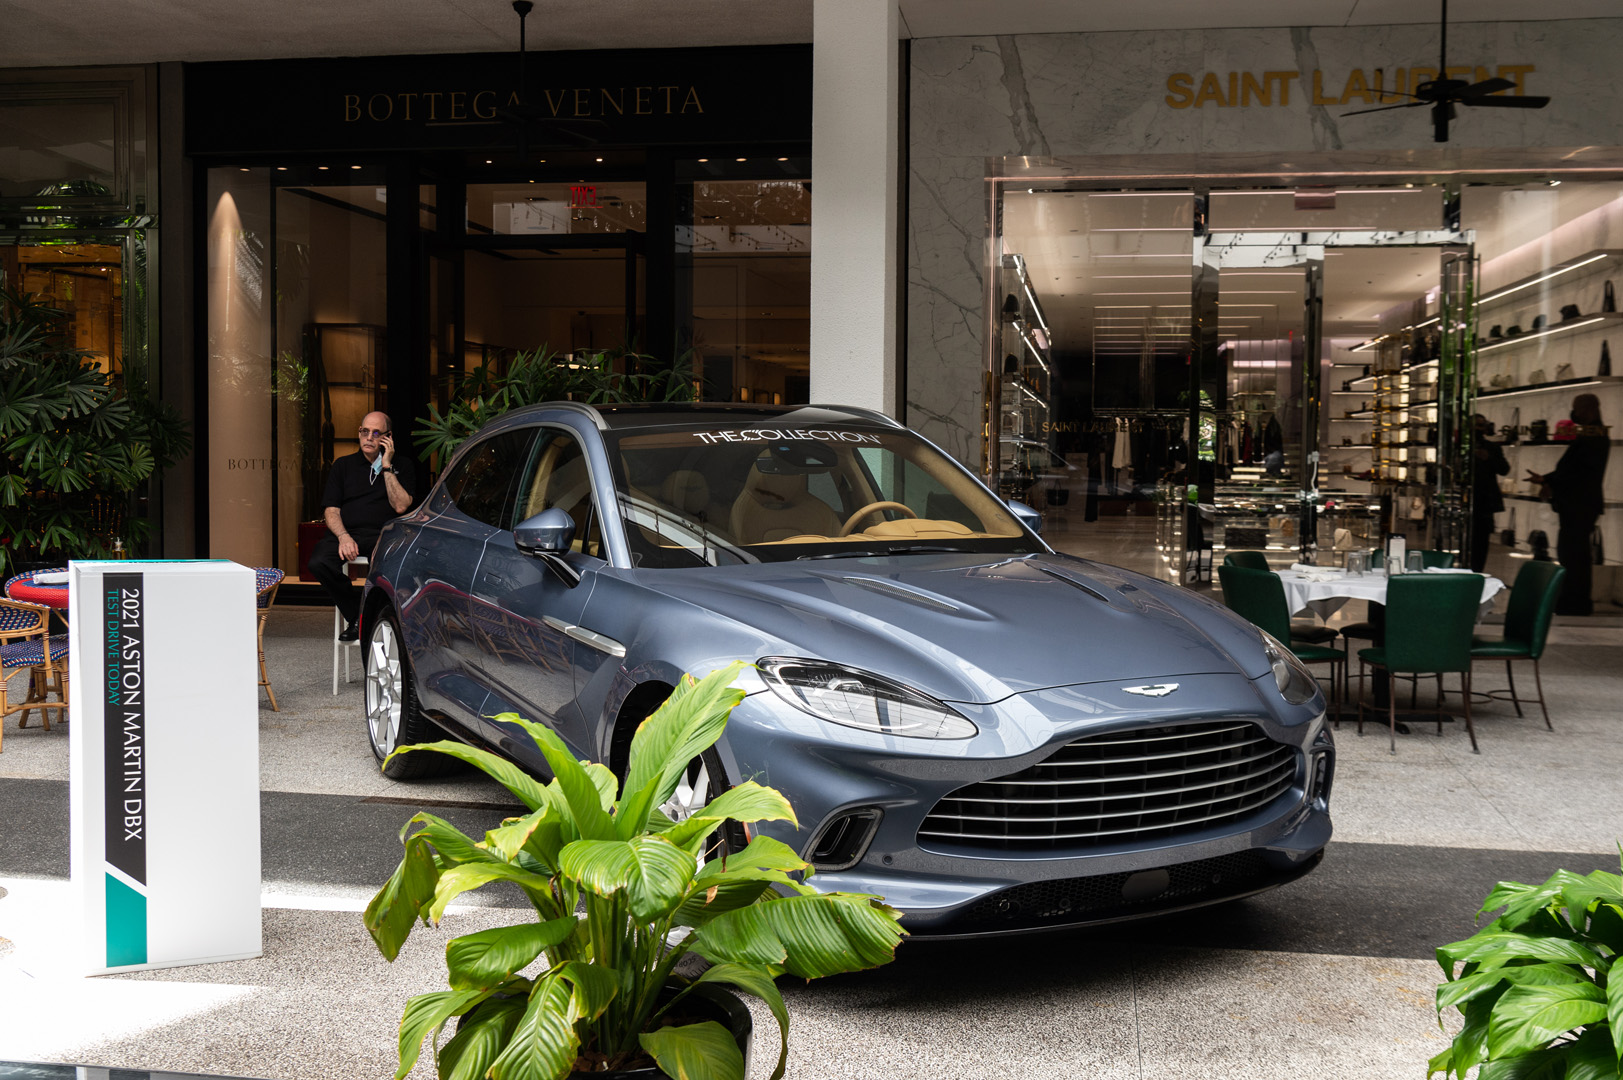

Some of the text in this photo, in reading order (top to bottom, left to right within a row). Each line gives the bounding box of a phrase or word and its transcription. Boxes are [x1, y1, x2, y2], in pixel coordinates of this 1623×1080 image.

[343, 85, 705, 122] BOTTEGA VENETA
[1165, 71, 1299, 109] SAINT
[107, 588, 120, 706] TEST DRIVE TODAY
[122, 588, 143, 842] 2021 ASTON MARTIN DBX
